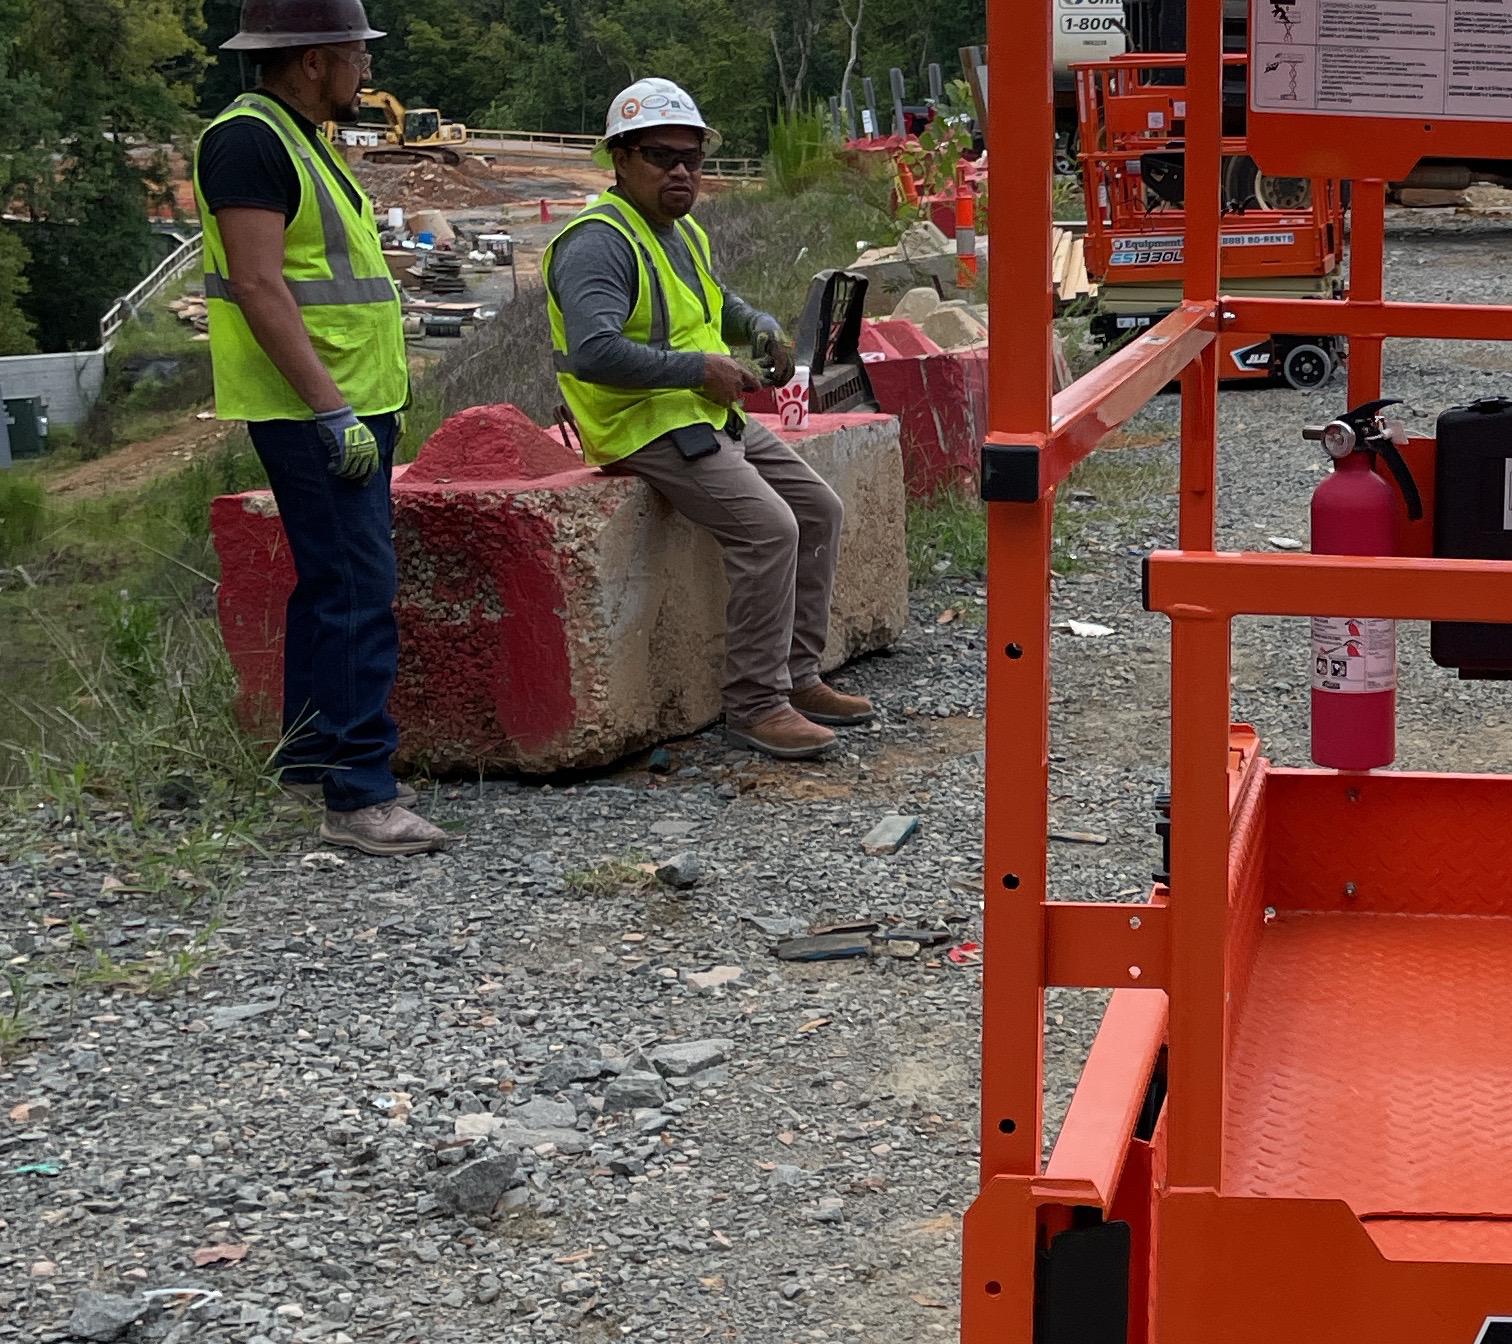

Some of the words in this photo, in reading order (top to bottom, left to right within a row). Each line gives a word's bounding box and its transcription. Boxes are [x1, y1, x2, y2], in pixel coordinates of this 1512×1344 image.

[1065, 17, 1123, 31] 1-800
[1124, 238, 1184, 250] Equipment
[1111, 252, 1183, 265] ES1330L
[1246, 353, 1270, 364] JLG
